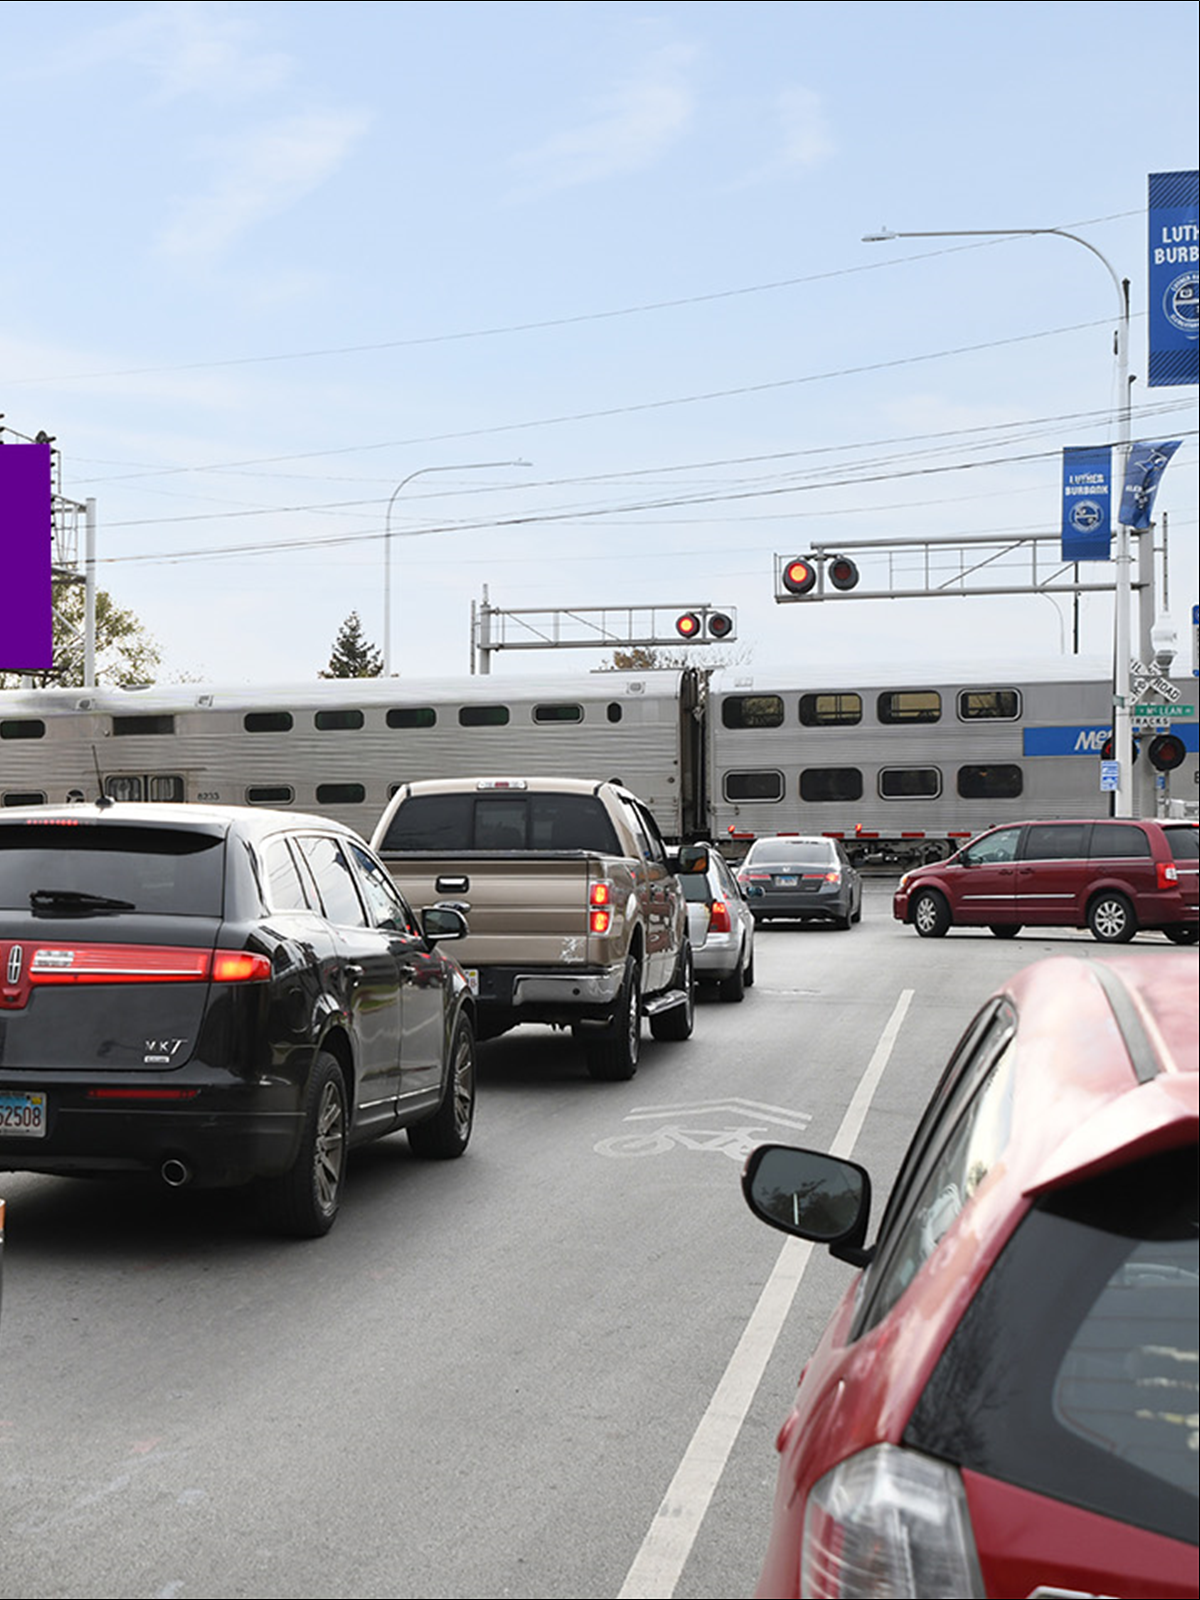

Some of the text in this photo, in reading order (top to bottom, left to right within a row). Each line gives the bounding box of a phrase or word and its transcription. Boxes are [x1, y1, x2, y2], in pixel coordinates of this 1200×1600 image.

[1154, 245, 1199, 264] BURB
[1152, 678, 1180, 701] ROAD
[145, 1039, 188, 1055] MKT
